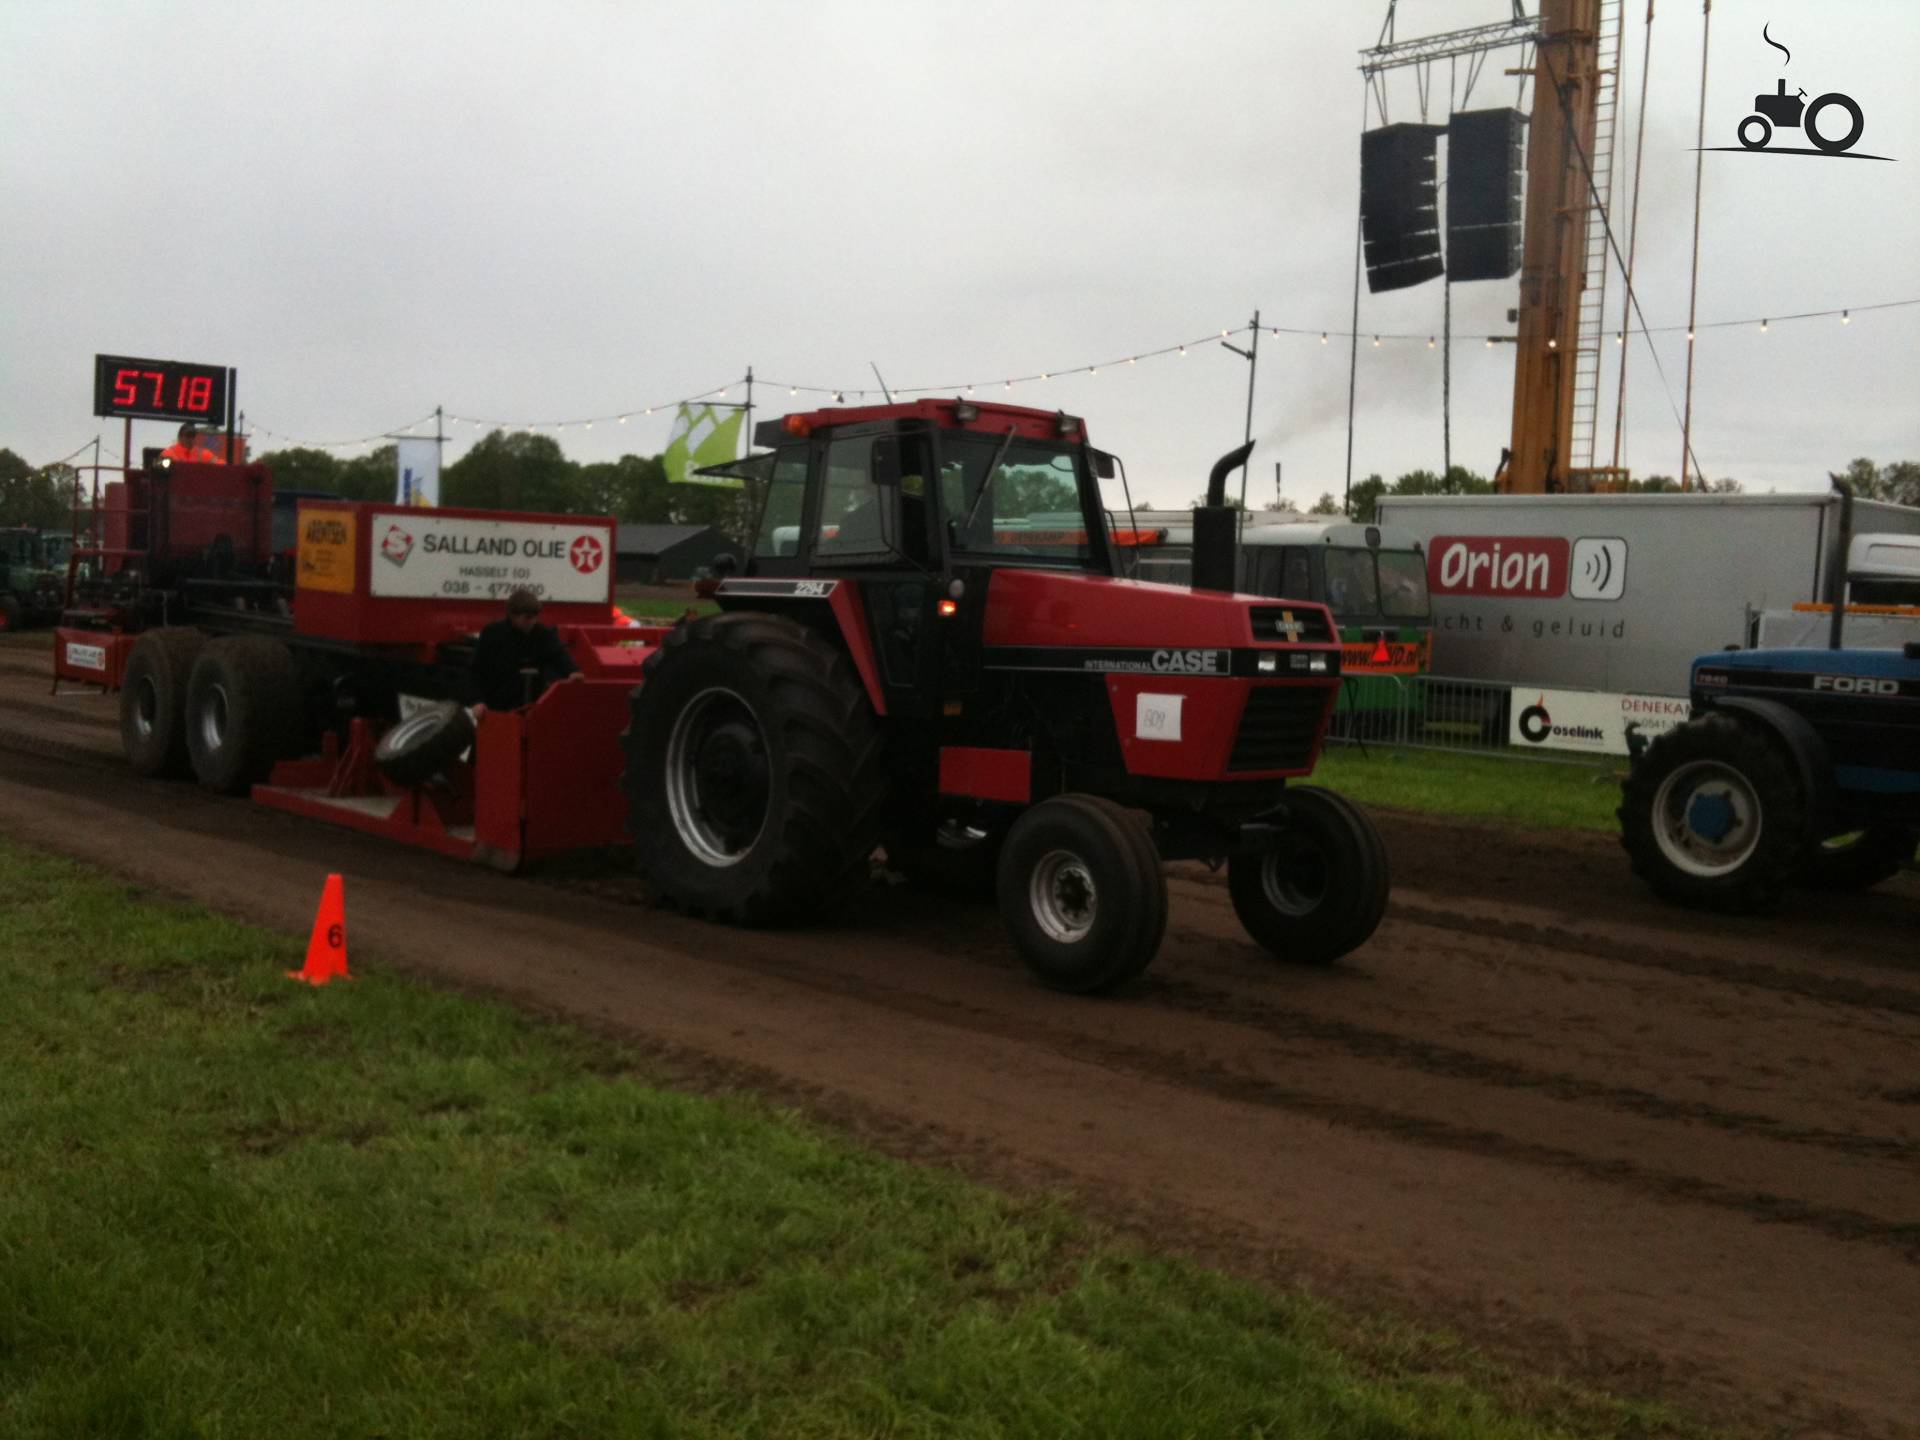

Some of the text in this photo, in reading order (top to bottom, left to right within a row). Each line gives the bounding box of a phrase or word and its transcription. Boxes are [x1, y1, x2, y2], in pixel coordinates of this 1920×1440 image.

[422, 533, 567, 559] SALLAND OLIE
[459, 566, 508, 579] HASSELT
[1440, 543, 1550, 591] Orion
[1433, 612, 1625, 639] icht & geluid
[1151, 650, 1218, 673] CASE
[1813, 675, 1900, 695] FORD
[327, 923, 342, 948] 6
